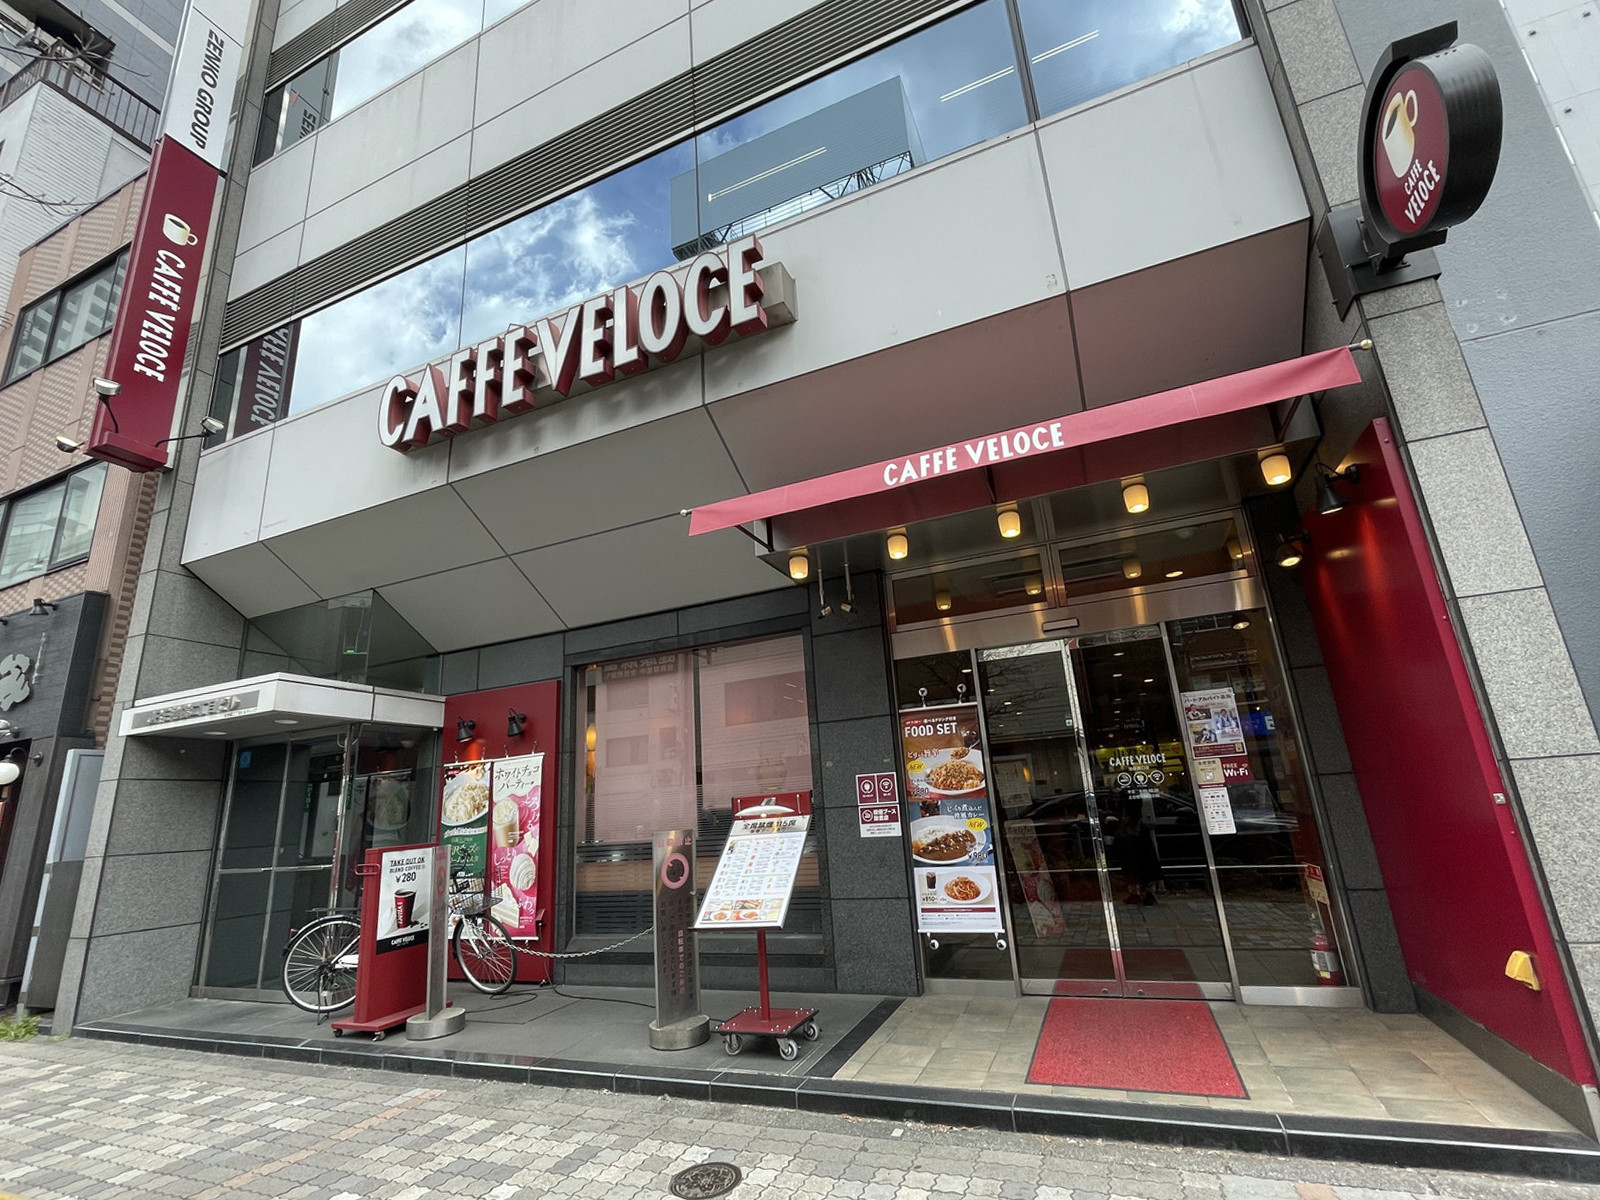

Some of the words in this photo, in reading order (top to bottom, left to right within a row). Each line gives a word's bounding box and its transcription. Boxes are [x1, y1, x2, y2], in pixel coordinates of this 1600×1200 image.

[190, 87, 215, 150] GROUP
[1404, 159, 1441, 224] VELOCE
[534, 234, 767, 397] VELOCE
[133, 309, 176, 383] VELOCE
[964, 421, 1065, 465] VELOCE
[904, 724, 934, 738] FOOD
[936, 722, 957, 735] SET
[1134, 753, 1167, 765] VELOCE
[968, 820, 984, 828] NEW
[390, 858, 405, 867] TAKE
[405, 857, 417, 865] OUT
[396, 871, 416, 883] ¥280
